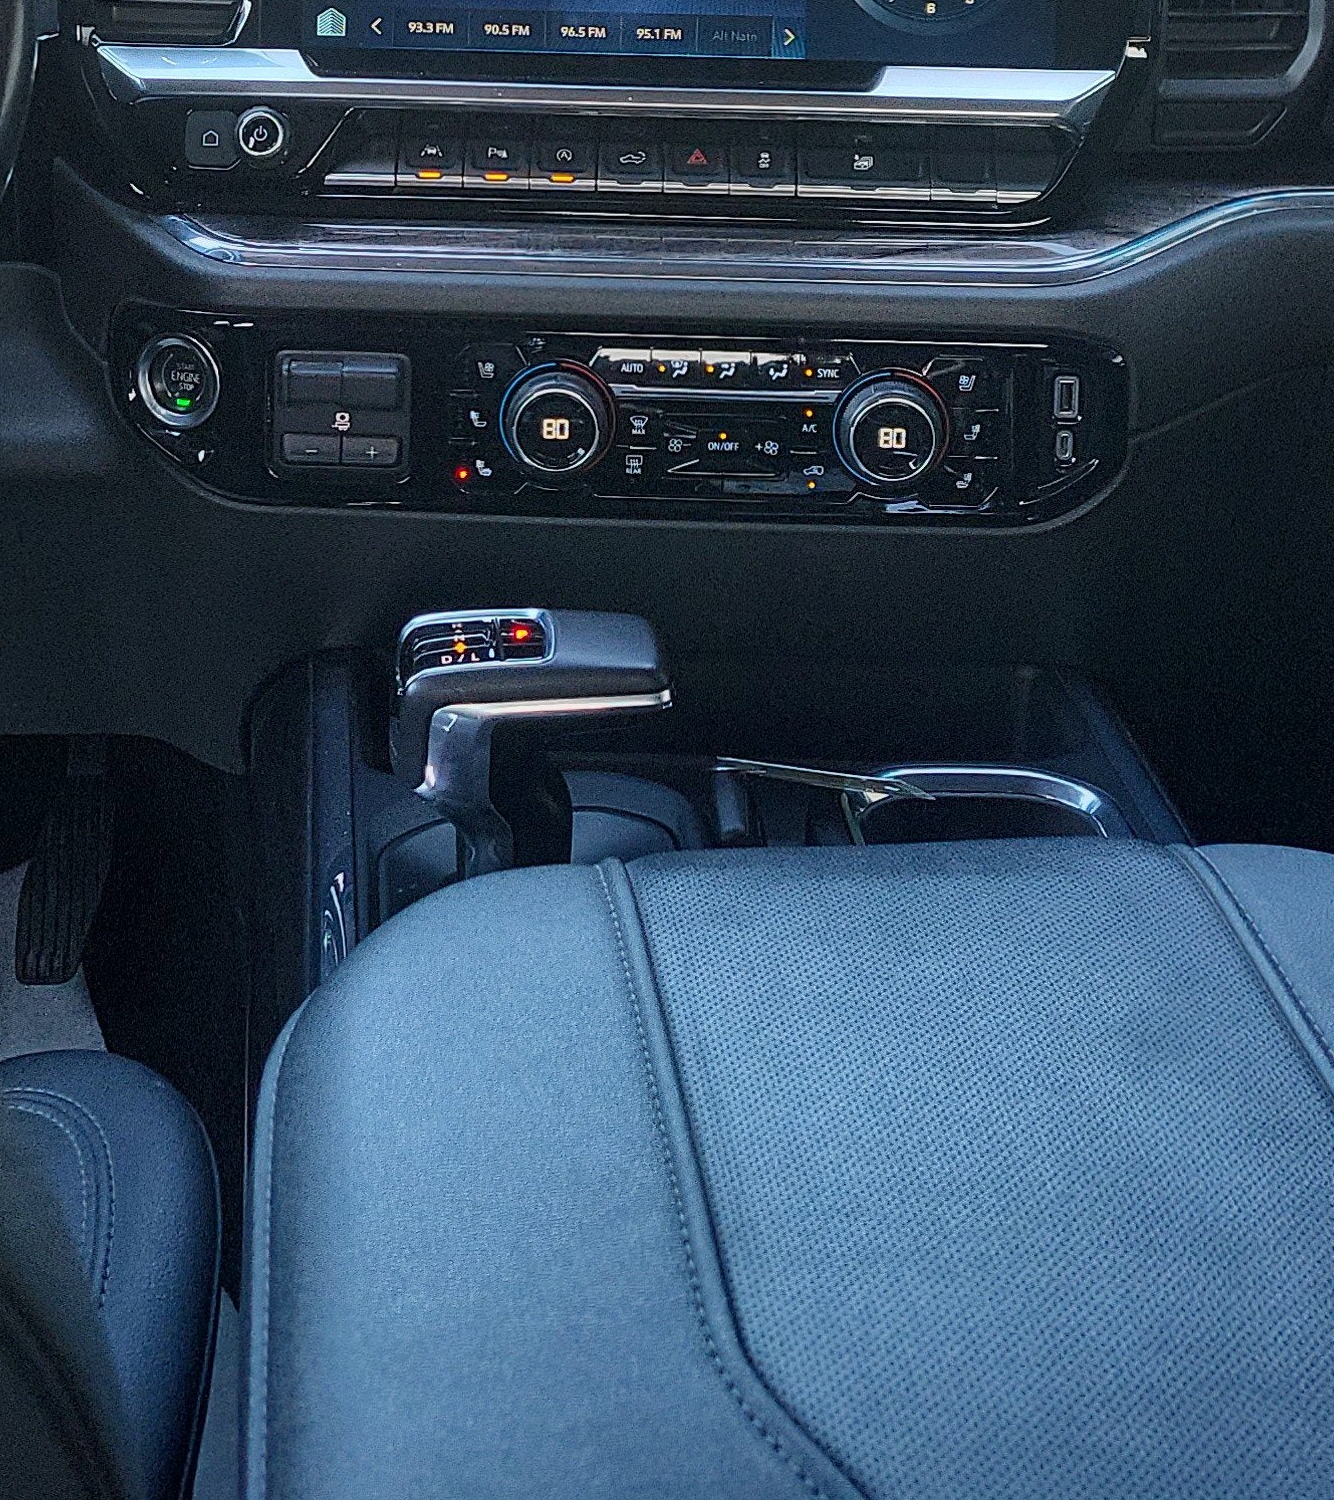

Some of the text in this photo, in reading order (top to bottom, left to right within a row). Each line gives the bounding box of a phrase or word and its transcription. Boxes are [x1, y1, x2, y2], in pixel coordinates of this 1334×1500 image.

[925, 2, 937, 14] 6
[408, 21, 455, 35] 93.3 FM
[483, 23, 531, 37] 90.5 FM
[560, 26, 607, 39] 96.5 FM
[636, 28, 683, 41] 95.1 FM
[620, 363, 645, 374] AUTO
[816, 368, 841, 379] SYNC
[170, 370, 202, 384] ENGINE
[178, 382, 195, 391] STOP
[542, 418, 570, 440] 80
[631, 428, 646, 436] MAX
[801, 423, 818, 433] A/C
[878, 427, 907, 450] 80
[707, 441, 740, 452] ON/OFF
